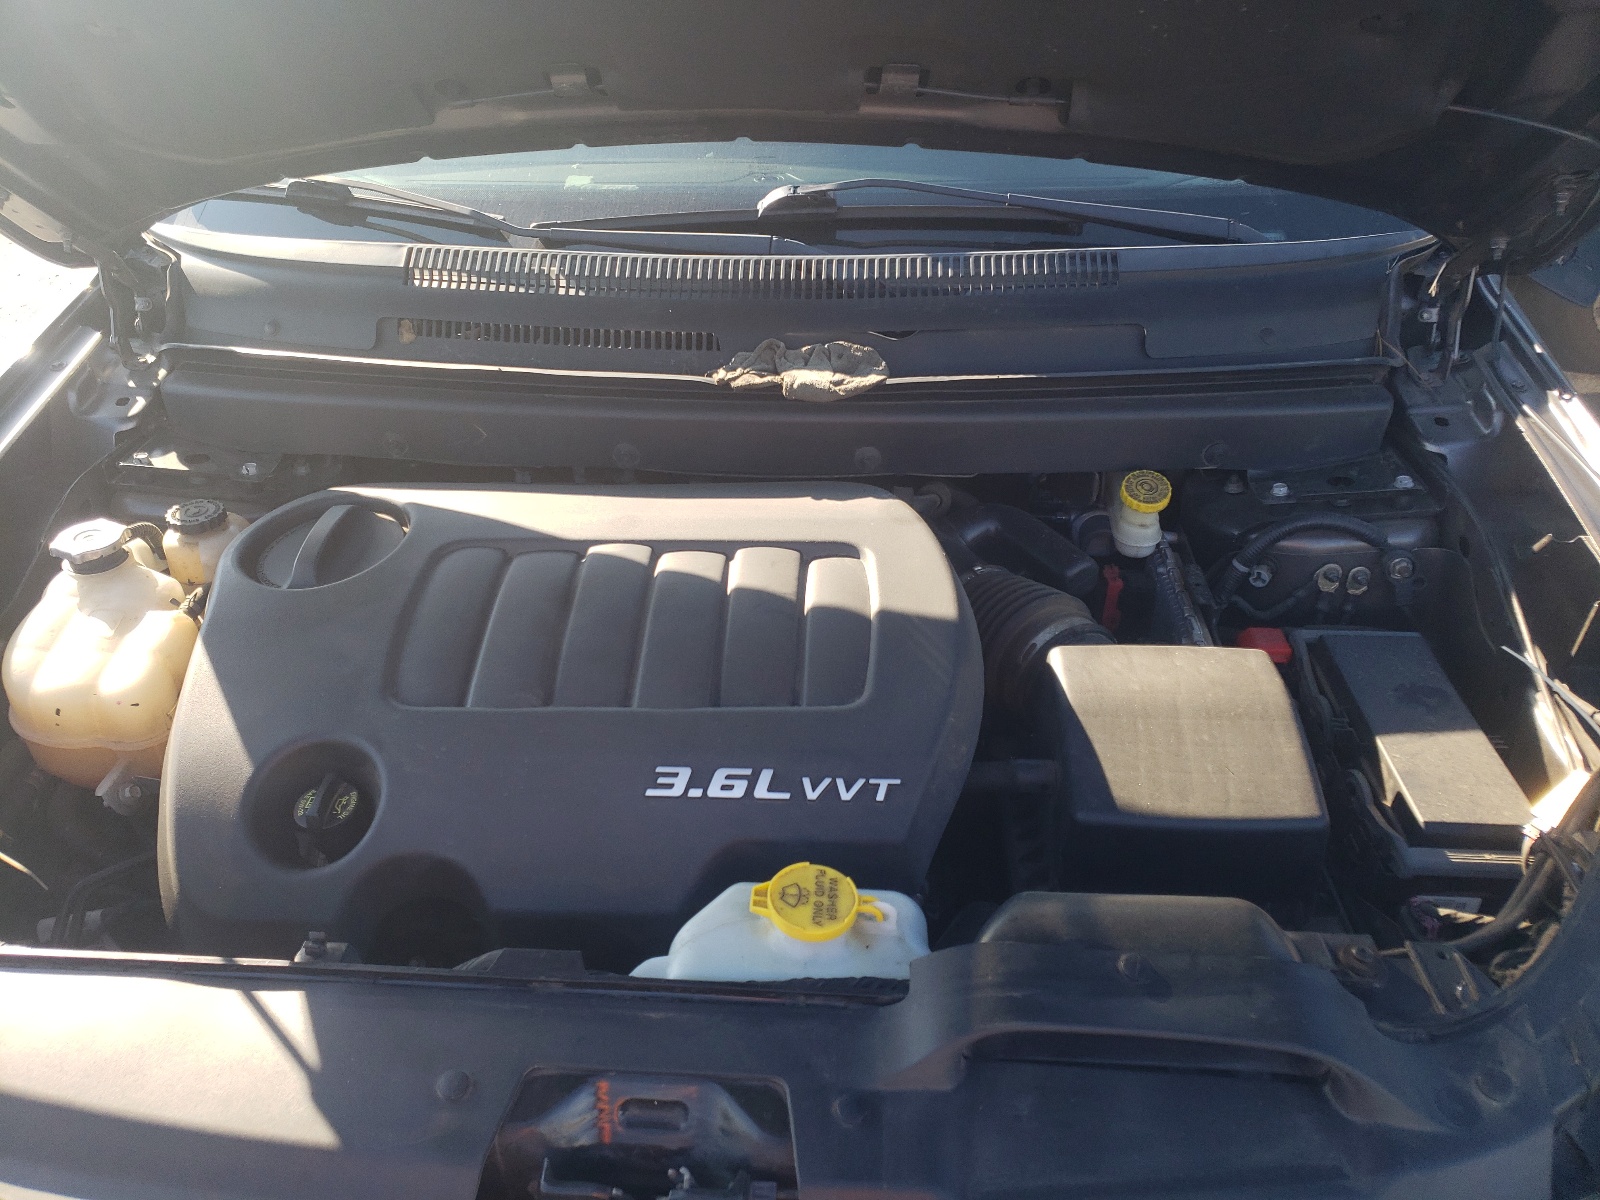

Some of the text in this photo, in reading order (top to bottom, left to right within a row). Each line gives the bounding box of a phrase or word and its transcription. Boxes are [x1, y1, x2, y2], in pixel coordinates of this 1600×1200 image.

[645, 766, 902, 802] 3.6L VVT
[337, 791, 358, 820] ENGINE OIL
[812, 868, 827, 927] FLUID ONLY
[826, 877, 839, 921] WASHER
